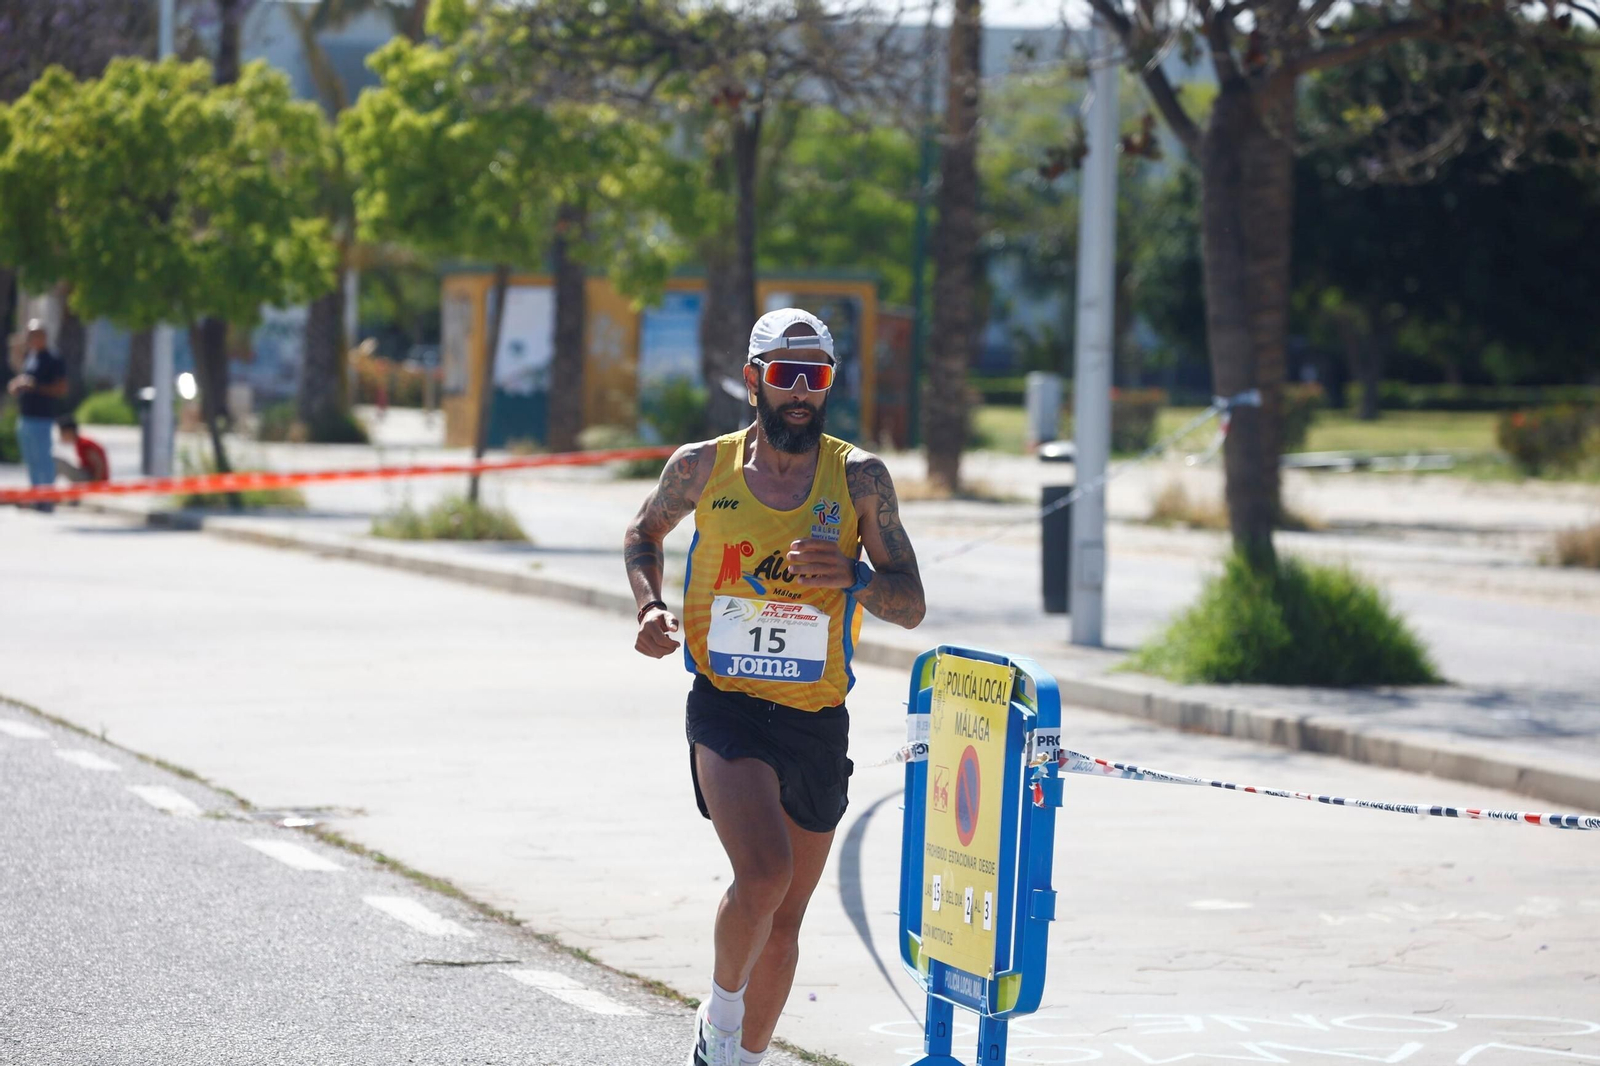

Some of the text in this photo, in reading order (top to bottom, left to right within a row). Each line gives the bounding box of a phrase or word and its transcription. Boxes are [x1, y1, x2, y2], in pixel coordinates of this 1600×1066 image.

[773, 588, 802, 600] Málaga
[761, 611, 819, 621] ATLETISMO
[749, 627, 786, 653] 15
[946, 670, 1007, 706] POLICÍA LOCAL
[955, 708, 990, 742] MÁLAGA
[948, 850, 977, 870] ESTACIONAR
[979, 858, 995, 876] DESDE
[934, 883, 940, 901] 15
[966, 896, 971, 915] 2
[985, 901, 990, 920] 3
